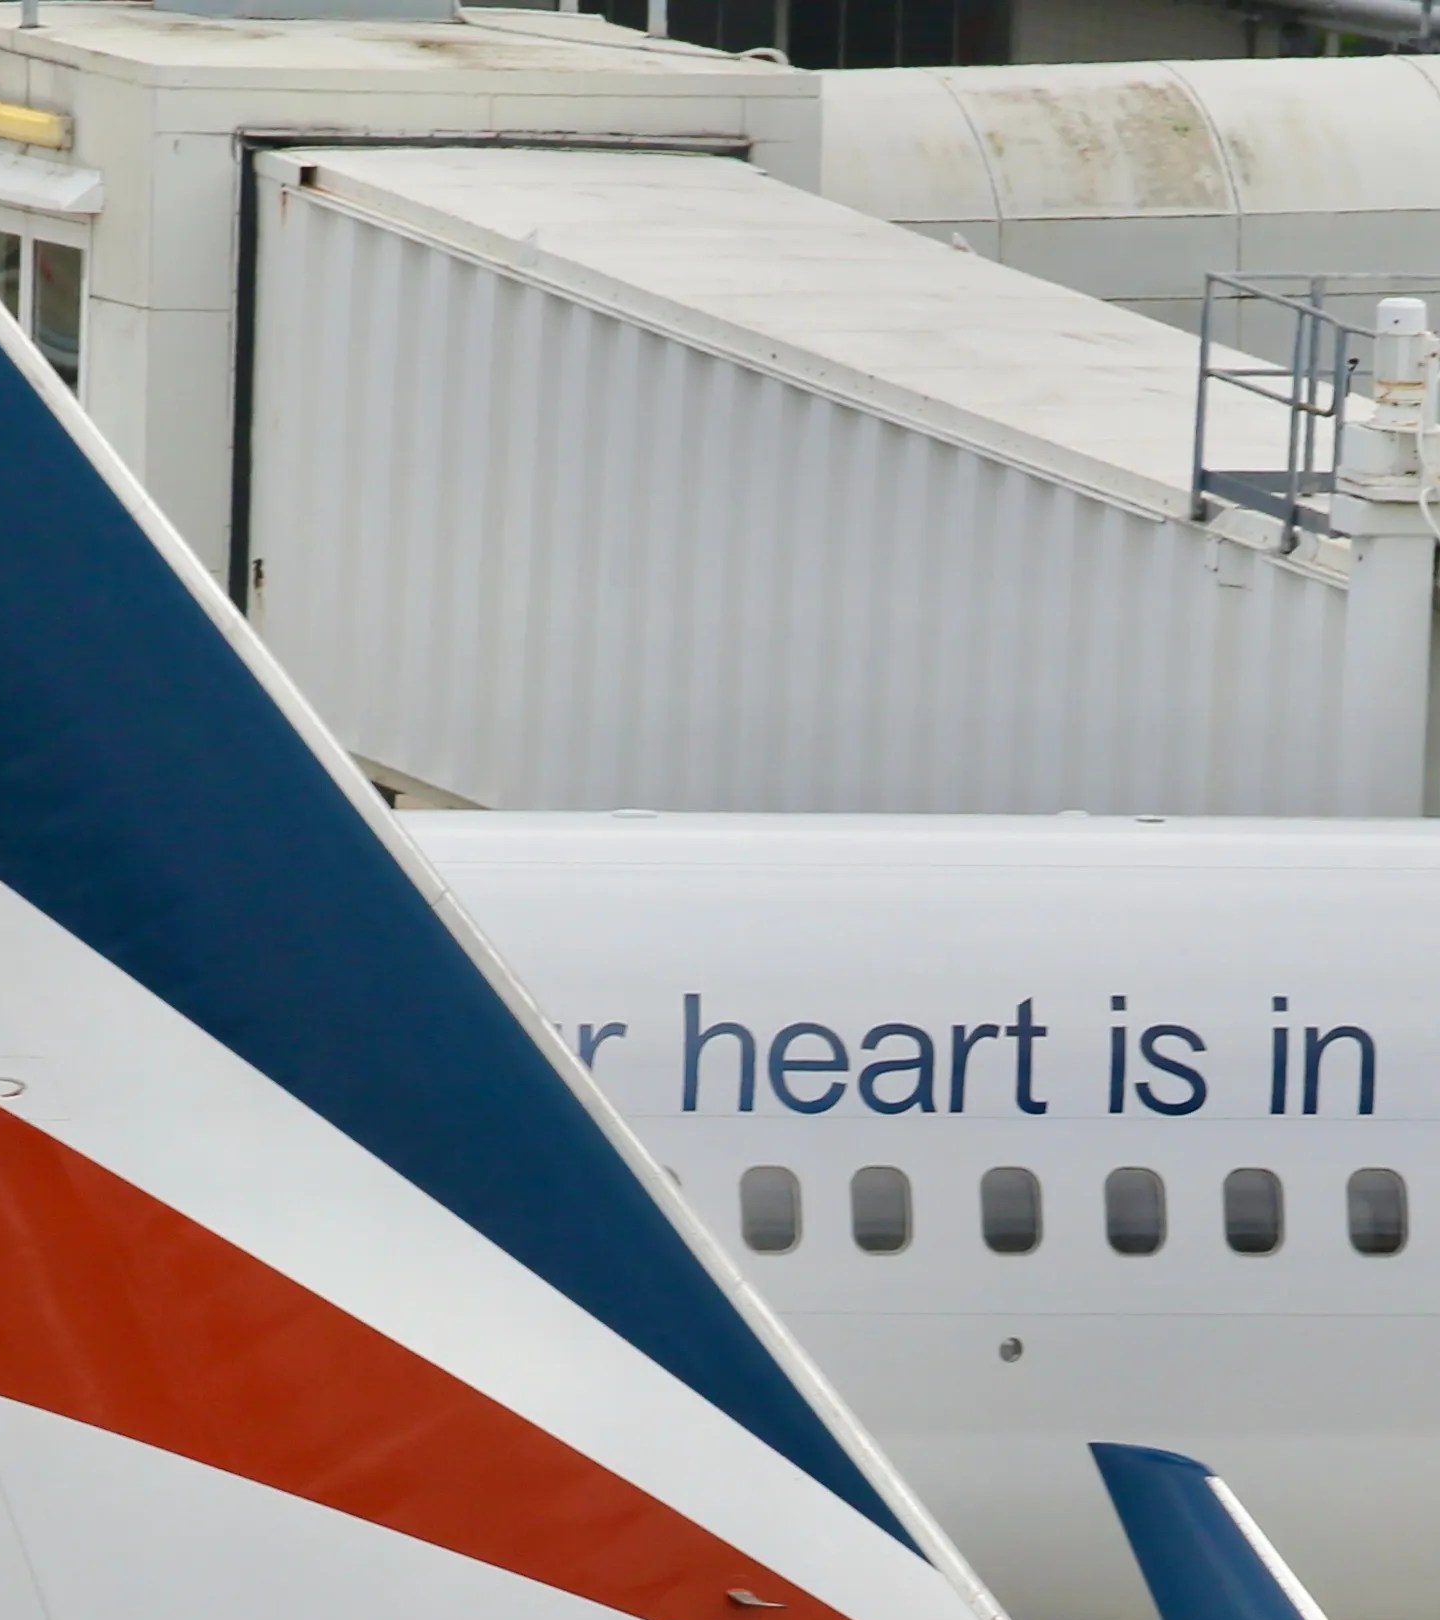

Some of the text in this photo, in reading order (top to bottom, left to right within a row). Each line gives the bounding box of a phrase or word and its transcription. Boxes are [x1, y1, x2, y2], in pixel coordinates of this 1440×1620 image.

[681, 993, 1048, 1116] heart
[1107, 995, 1209, 1118] is
[1269, 996, 1377, 1117] in
